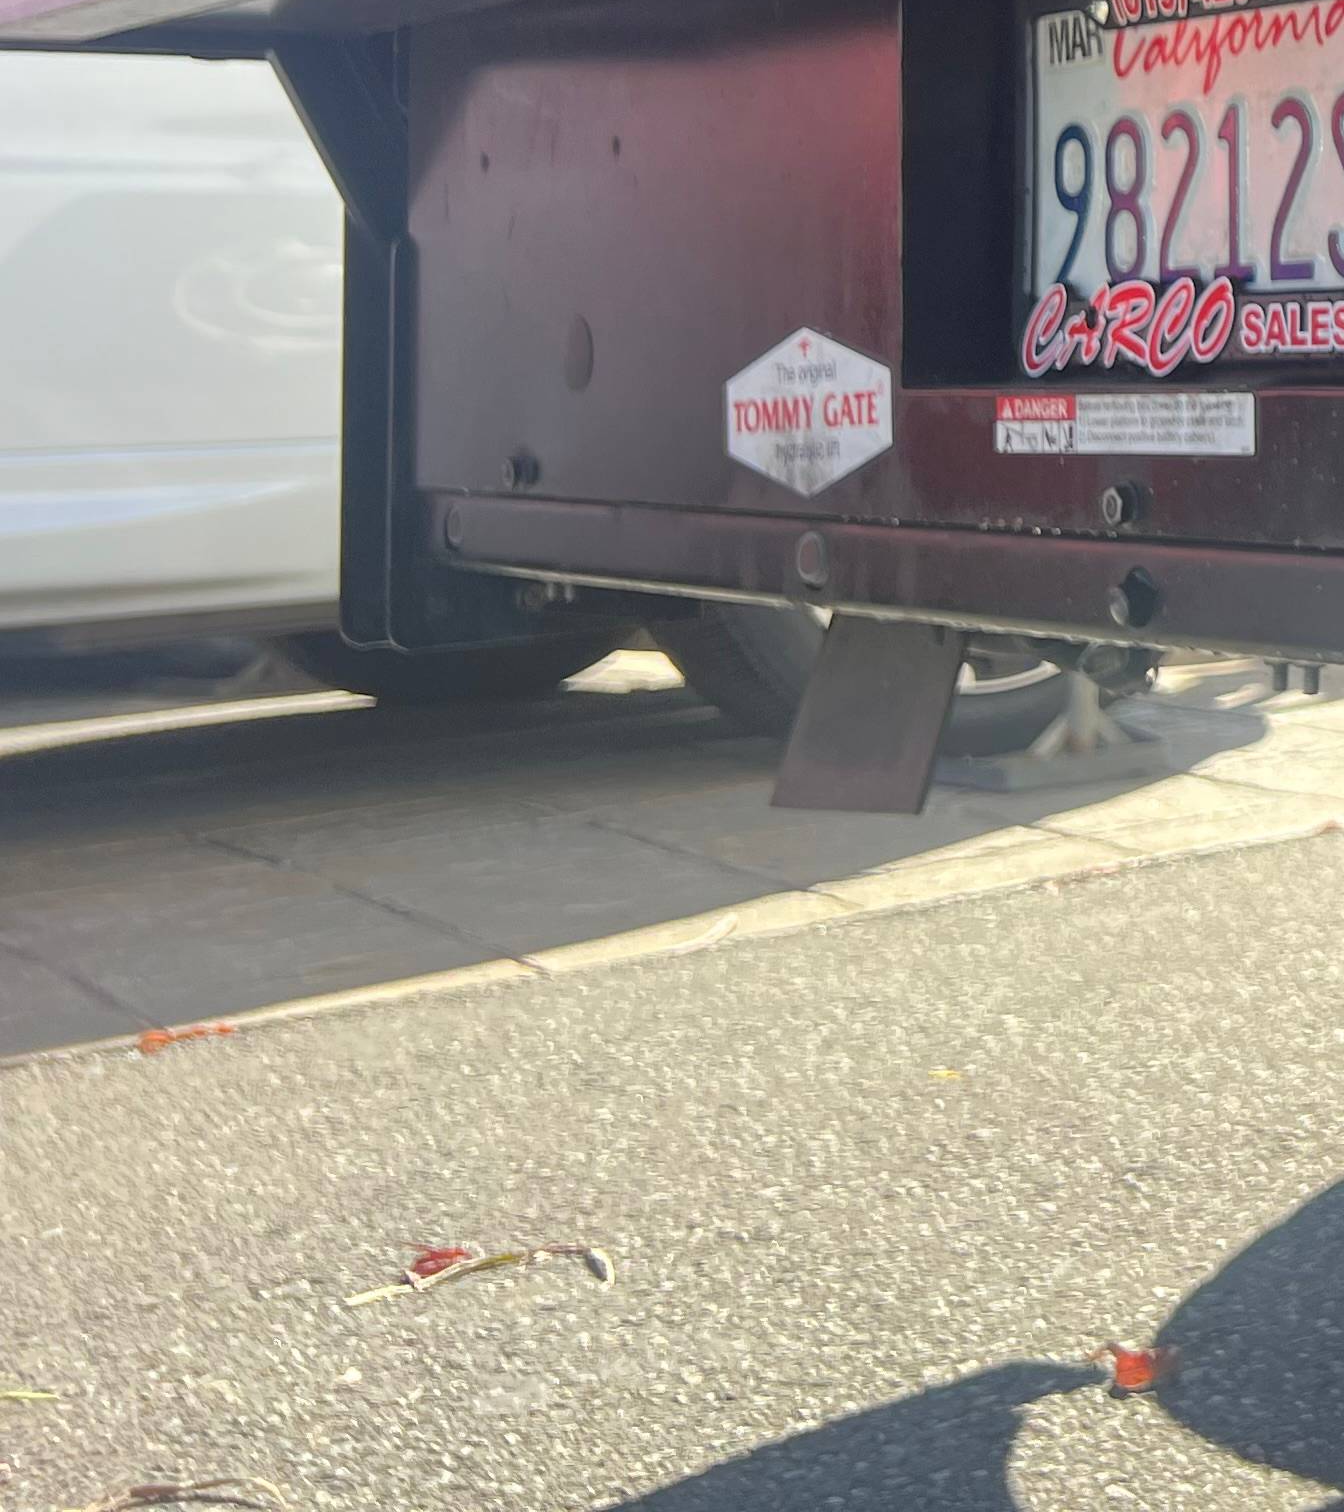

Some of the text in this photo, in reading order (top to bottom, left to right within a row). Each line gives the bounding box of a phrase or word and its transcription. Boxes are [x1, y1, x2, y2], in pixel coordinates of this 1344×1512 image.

[1048, 15, 1104, 65] MAR
[1022, 276, 1234, 378] CARCO
[734, 391, 880, 433] TOMMY GATE
[1014, 397, 1068, 419] DANGER
